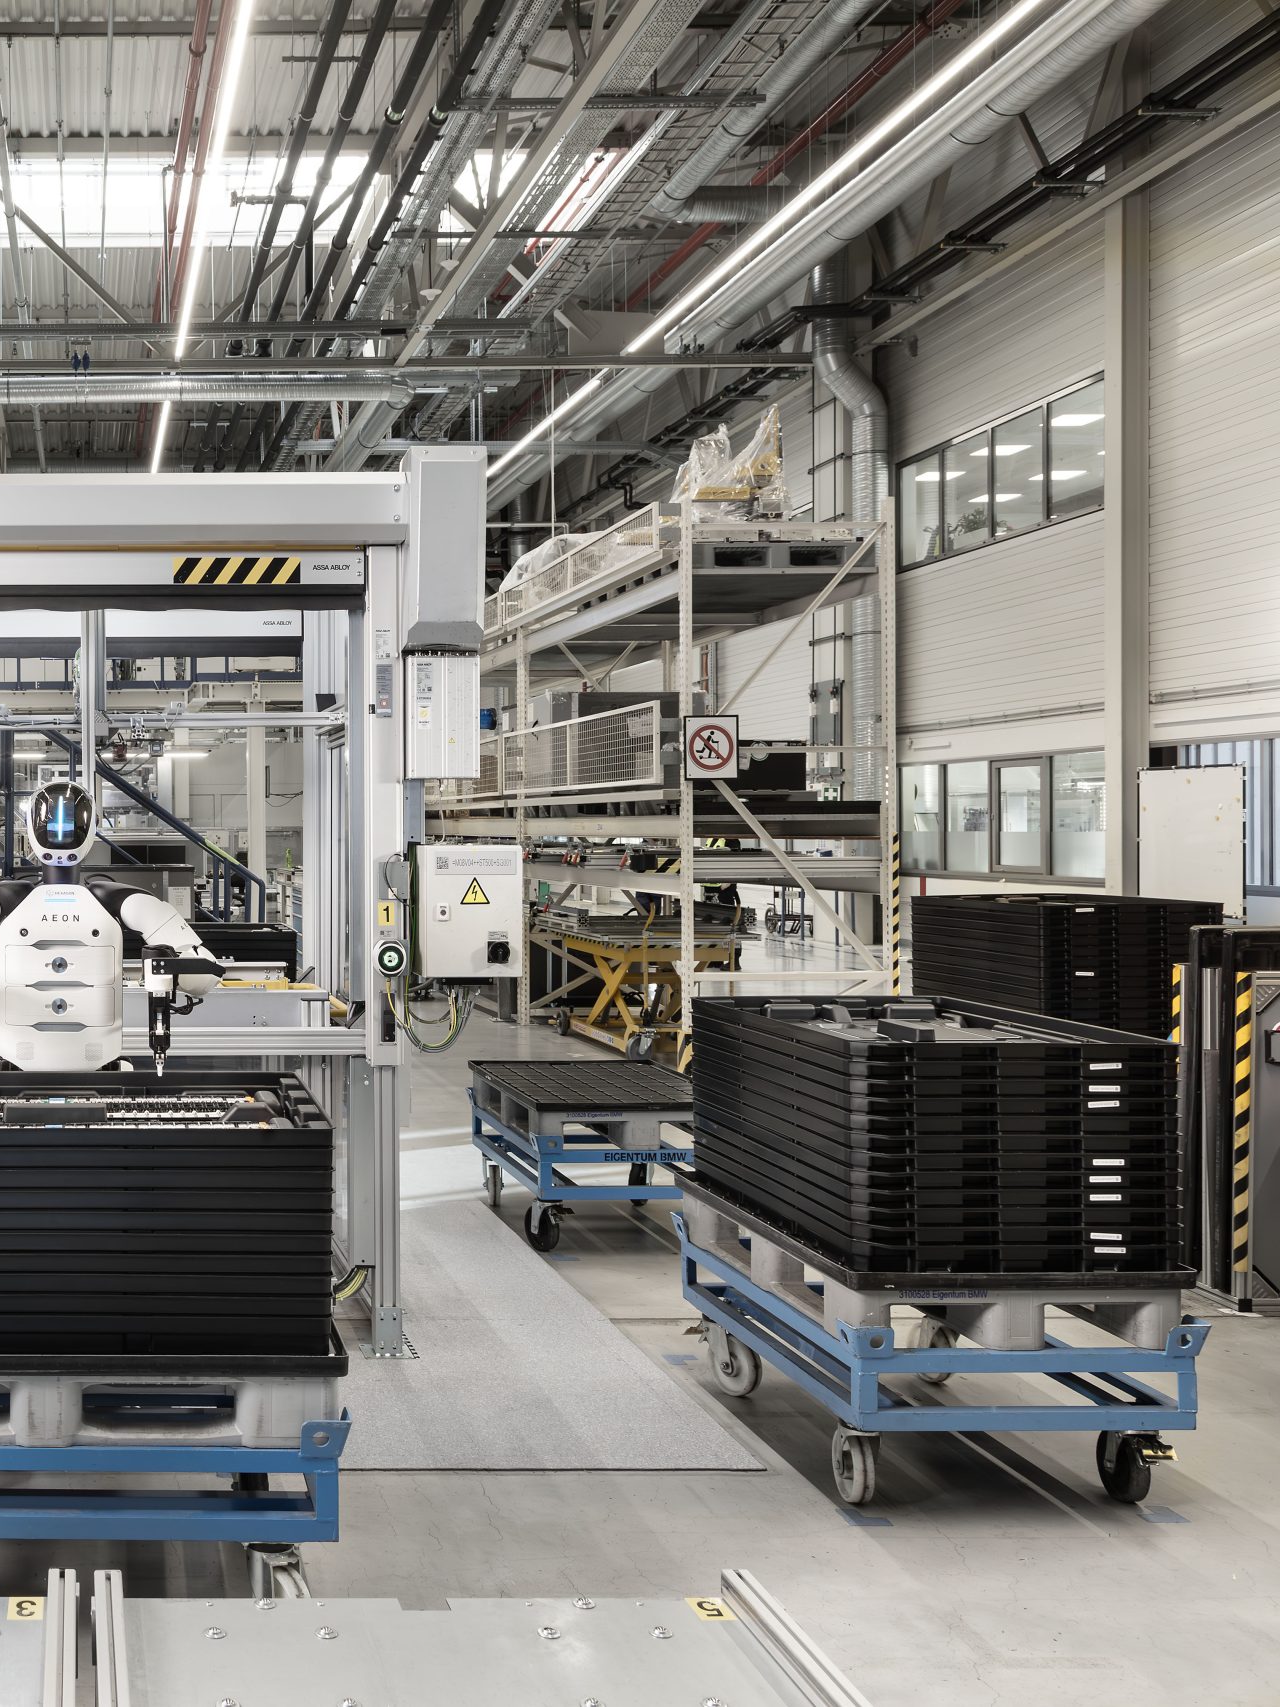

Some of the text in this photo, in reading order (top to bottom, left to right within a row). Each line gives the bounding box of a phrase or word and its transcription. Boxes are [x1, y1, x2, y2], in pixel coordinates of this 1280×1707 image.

[41, 914, 80, 922] AEON
[383, 905, 390, 923] 1
[604, 1152, 687, 1162] EIGENTUM BMW
[932, 1290, 966, 1300] Eigentum
[967, 1289, 988, 1299] BMW
[16, 1600, 37, 1617] 3
[696, 1600, 724, 1617] 5
